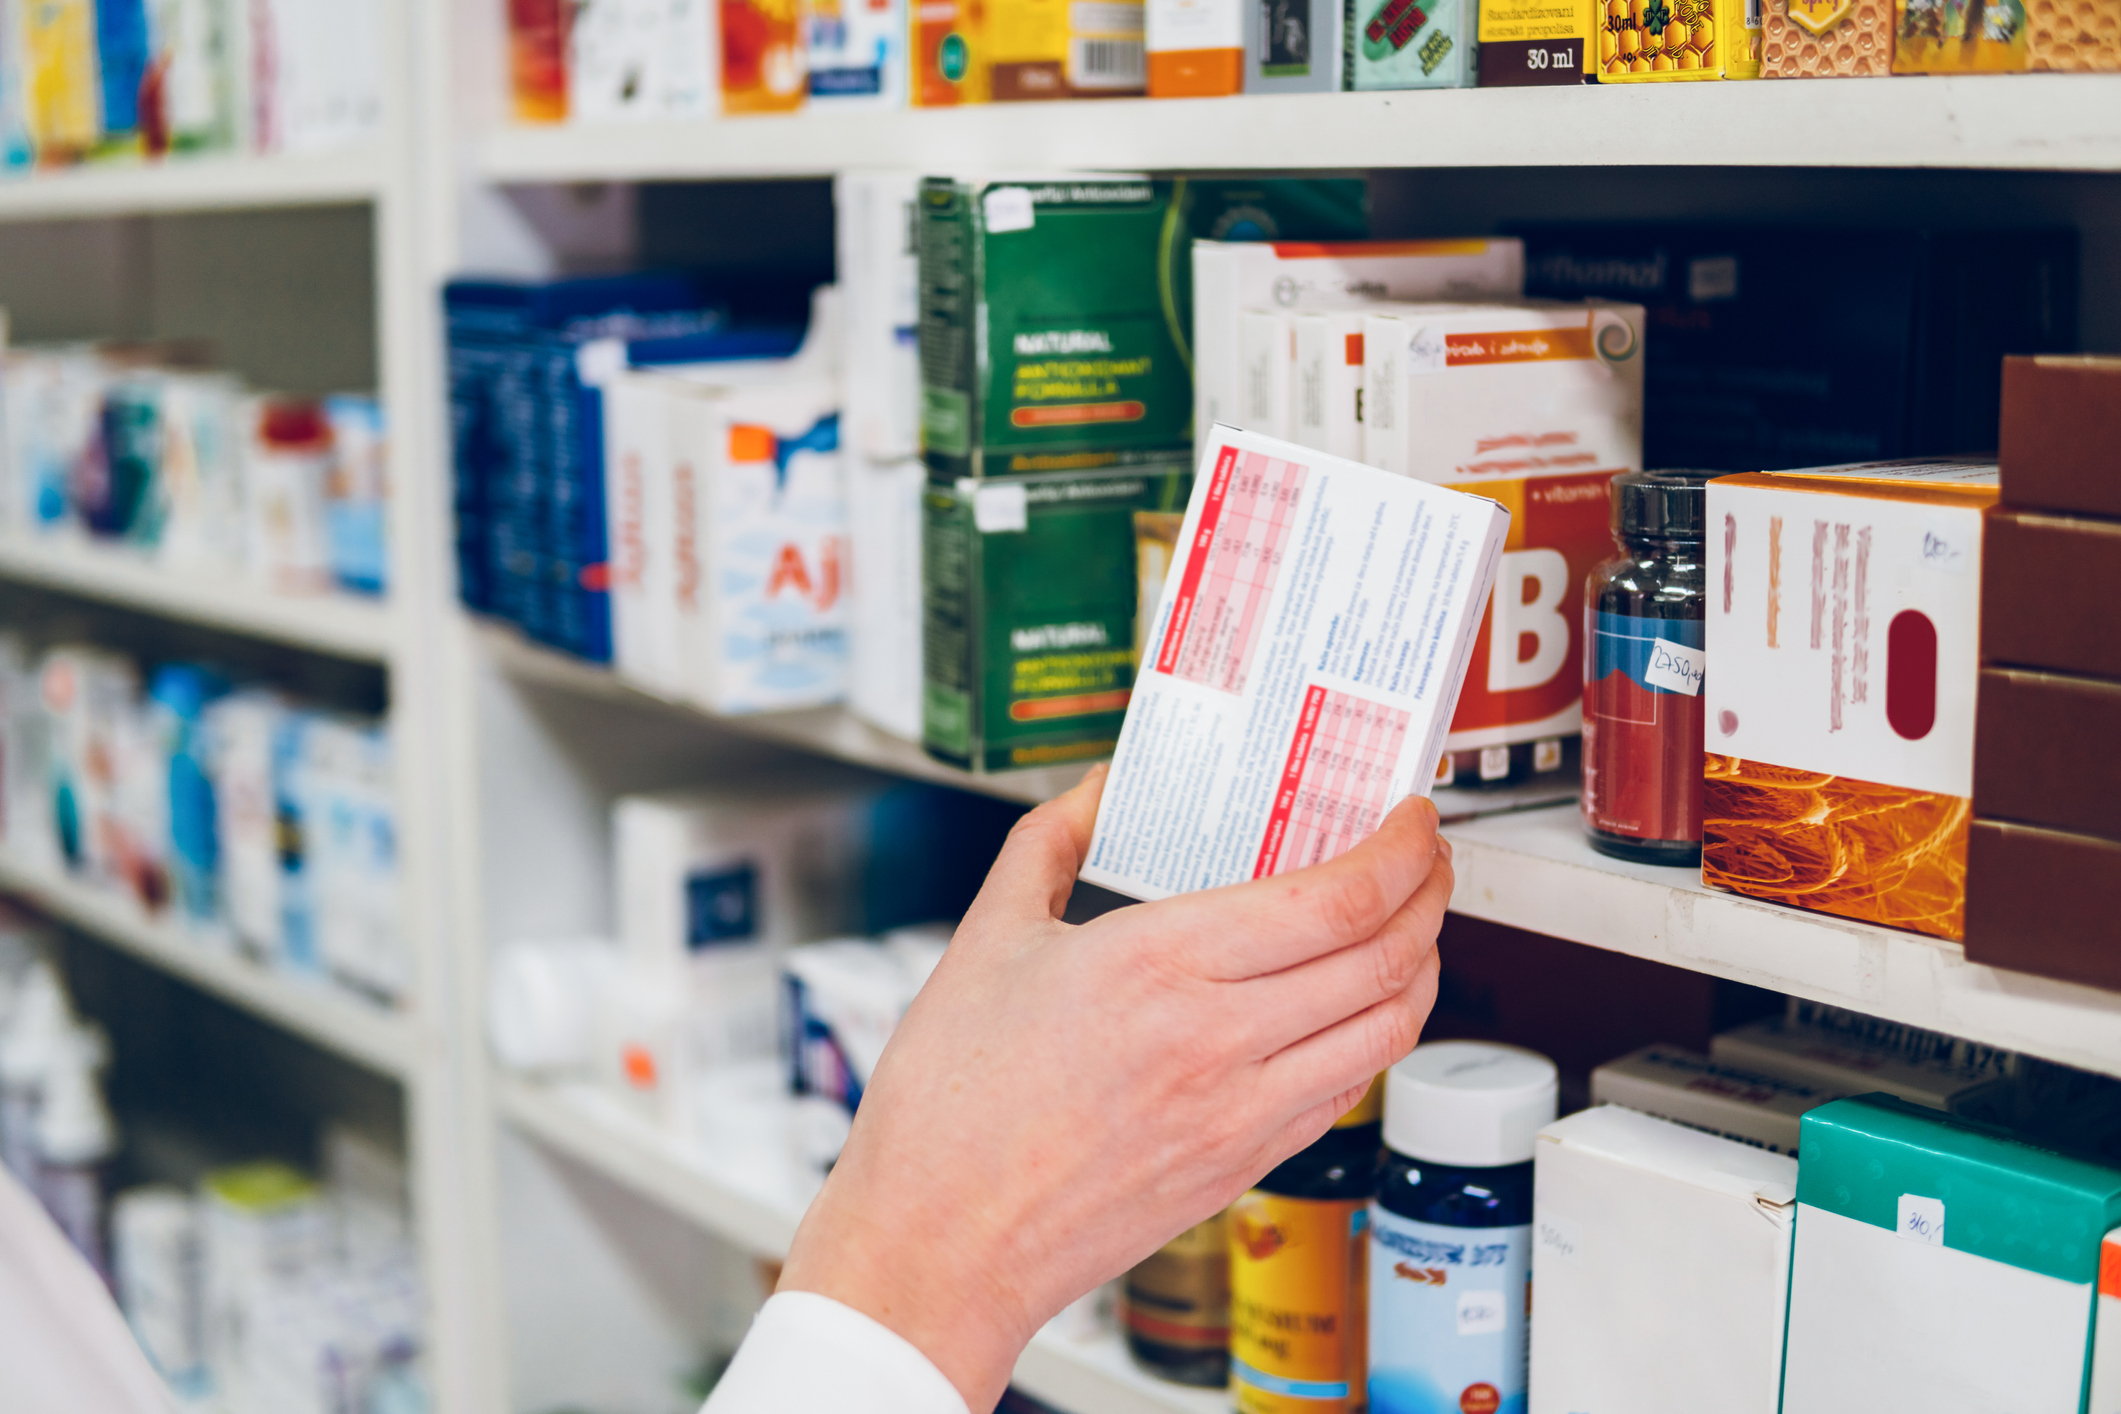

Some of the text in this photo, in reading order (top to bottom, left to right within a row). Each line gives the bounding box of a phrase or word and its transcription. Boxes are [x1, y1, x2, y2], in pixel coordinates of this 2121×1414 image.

[1607, 13, 1637, 32] 30ml
[1527, 48, 1574, 69] 30 ml
[1012, 330, 1113, 354] NATURAL
[1163, 596, 1189, 665] Nutritivne vrednosti
[1487, 548, 1571, 693] B
[1317, 613, 1341, 670] Način upotrebe:
[1354, 639, 1372, 681] Napomene:
[1389, 671, 1400, 691] Način
[1267, 819, 1284, 852] sastojaka
